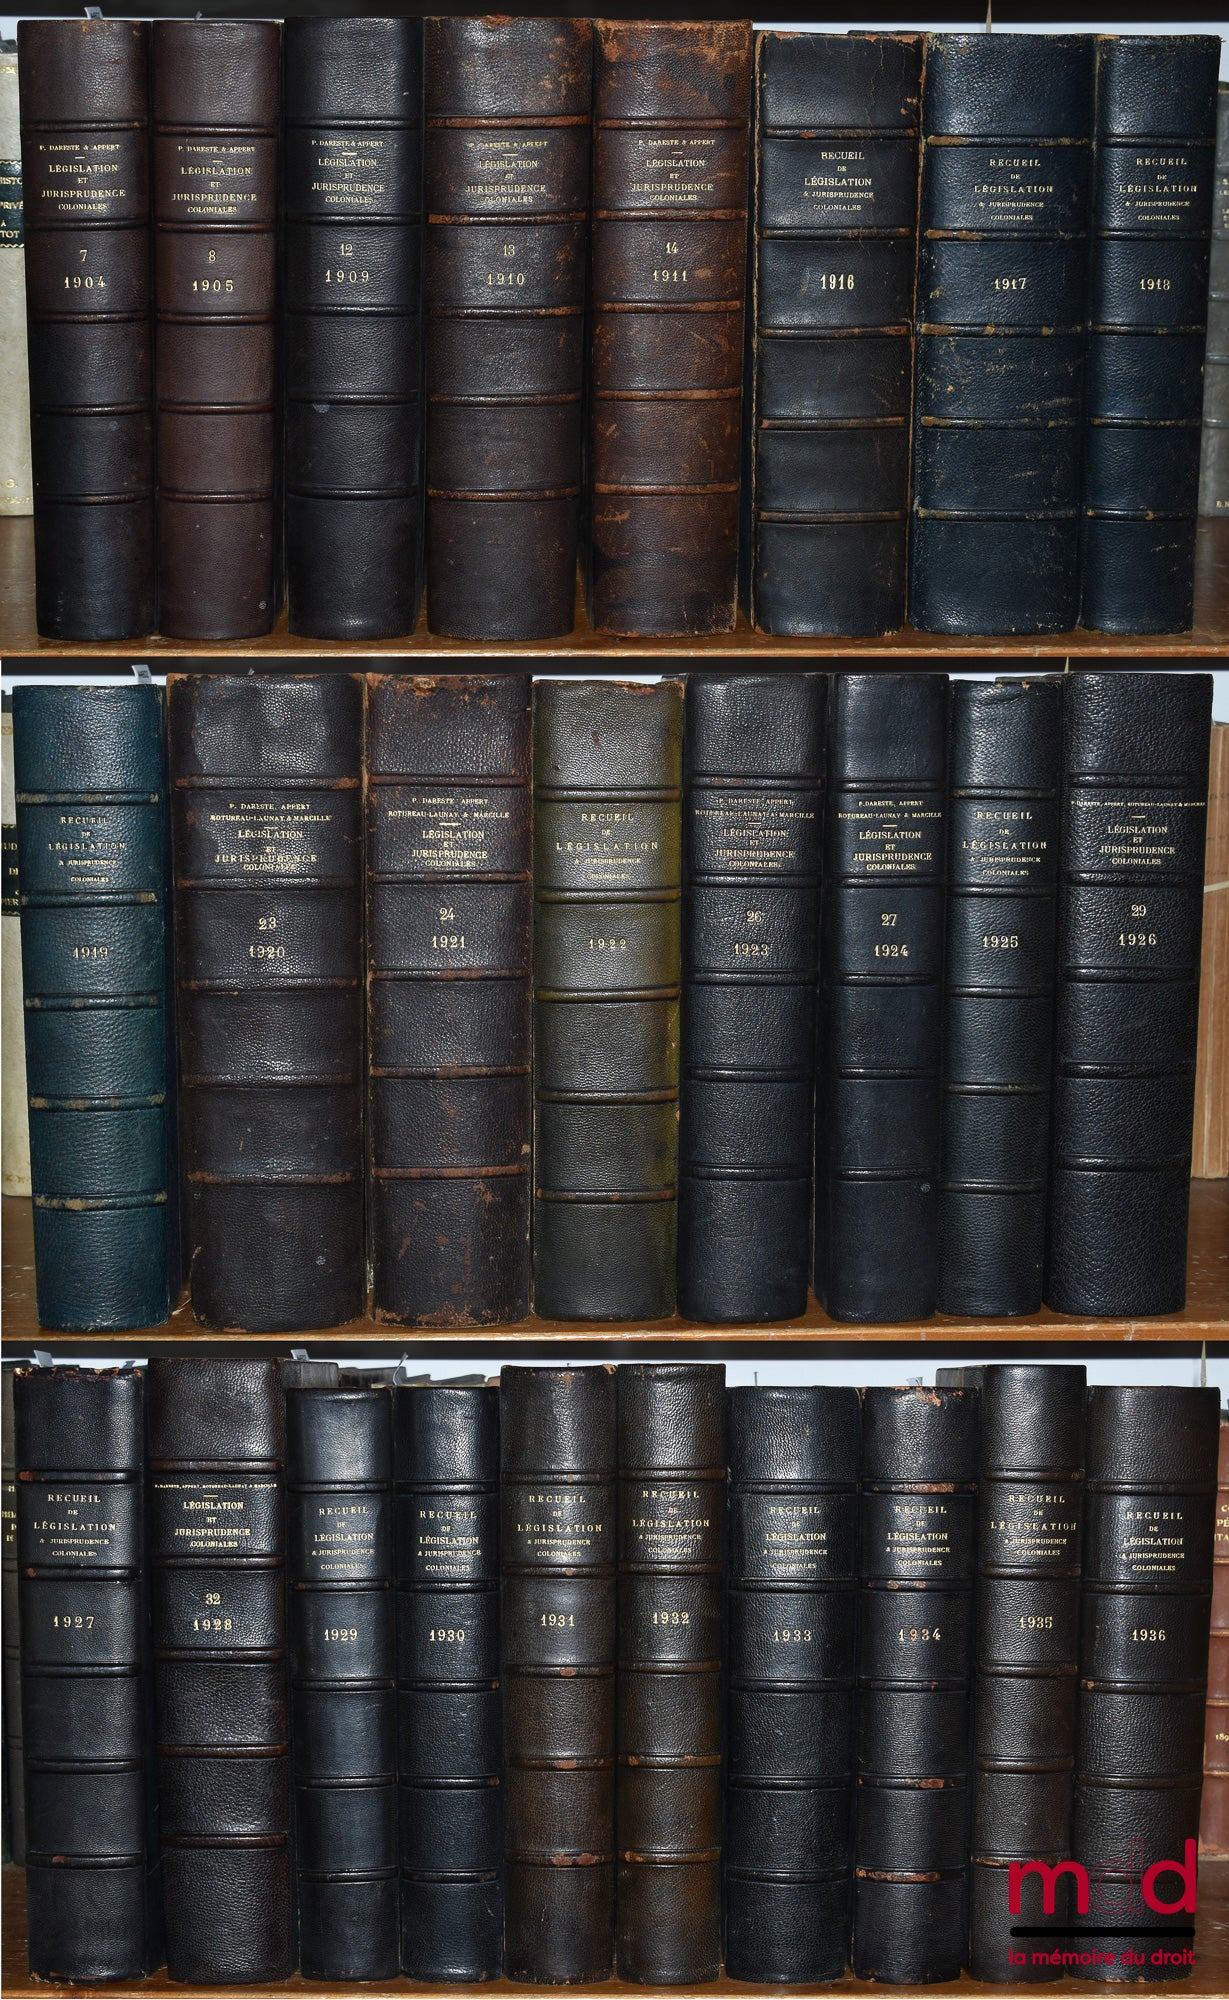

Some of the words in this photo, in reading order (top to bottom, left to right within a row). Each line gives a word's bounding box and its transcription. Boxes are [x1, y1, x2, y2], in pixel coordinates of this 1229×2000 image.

[647, 138, 678, 146] DARESTE
[318, 156, 377, 167] LÉGISLATION
[820, 152, 864, 160] RECUEIL
[49, 163, 119, 173] LÉGISLATION
[479, 158, 538, 168] LÉGISLATION
[646, 157, 705, 168] LÉGISLATION
[989, 159, 1040, 167] RECUEIL
[180, 166, 252, 175] LÉGISLATION
[210, 180, 220, 188] ET
[631, 182, 713, 192] JURISPRUDENCE
[804, 177, 872, 186] LÉGISLATION
[312, 183, 384, 192] JURISPRUDENCE
[466, 184, 546, 193] JURISPRUDENCE
[974, 183, 1053, 193] LÉGISLATION
[1119, 182, 1197, 193] LÉGISLATION
[42, 189, 125, 198] JURISPRUDENCE
[171, 193, 257, 202] JURISPRUDENCE
[650, 194, 697, 202] COLONIALES
[58, 203, 107, 211] COLONIALES
[340, 244, 353, 256] 12
[502, 244, 515, 256] 13
[665, 241, 678, 255] 14
[79, 249, 88, 262] 7
[208, 250, 216, 262] 8
[325, 270, 369, 283] 1909
[487, 273, 525, 285] 1910
[652, 269, 688, 283] 1911
[64, 277, 106, 289] 1904
[192, 279, 234, 292] 1905
[821, 275, 854, 290] 1916
[994, 278, 1026, 290] 1917
[1140, 278, 1170, 290] 1918
[581, 813, 635, 822] RECUEIL
[976, 811, 1032, 820] RECUEIL
[422, 829, 484, 840] LÉGISLATION
[723, 828, 787, 837] LÉGISLATION
[859, 829, 921, 840] LÉGISLATION
[1107, 824, 1168, 834] LÉGISLATION
[556, 840, 659, 851] LÉGISLATION
[962, 839, 1047, 849] LÉGISLATION
[411, 849, 488, 860] JURISPRUDENCE
[715, 849, 794, 858] JURISPRUDENCE
[1100, 846, 1175, 854] JURISPRUDENCE
[853, 852, 932, 861] JURISPRUDENCE
[439, 908, 455, 921] 24
[747, 910, 762, 923] 26
[1131, 905, 1146, 917] 29
[258, 917, 276, 930] 23
[881, 913, 897, 926] 27
[432, 935, 466, 949] 1921
[588, 938, 628, 949] 1922
[983, 936, 1018, 948] 1925
[1119, 933, 1156, 946] 1926
[73, 947, 108, 958] 1919
[248, 946, 284, 958] 1920
[734, 943, 768, 956] 1923
[874, 944, 908, 957] 1924
[48, 1494, 100, 1502] RECUEIL
[528, 1495, 585, 1503] RECUEIL
[642, 1490, 699, 1499] RECUEIL
[1008, 1495, 1065, 1503] RECUEIL
[183, 1501, 243, 1510] LÉGISLATION
[319, 1507, 369, 1515] RECUEIL
[770, 1506, 819, 1514] RECUEIL
[895, 1506, 946, 1514] RECUEIL
[420, 1511, 477, 1519] RECUEIL
[1127, 1511, 1182, 1520] RECUEIL
[34, 1520, 117, 1531] LÉGISLATION
[517, 1523, 602, 1533] LÉGISLATION
[632, 1518, 709, 1528] LÉGISLATION
[175, 1528, 251, 1537] JURISPRUDENCE
[314, 1531, 373, 1542] LÉGISLATION
[767, 1532, 826, 1541] LÉGISLATION
[888, 1531, 948, 1540] LÉGISLATION
[419, 1535, 479, 1545] LÉGISLATION
[206, 1593, 220, 1605] 32
[53, 1616, 94, 1628] 1927
[541, 1614, 574, 1627] 1931
[653, 1612, 689, 1624] 1932
[1019, 1616, 1052, 1629] 1935
[193, 1619, 232, 1631] 1928
[324, 1629, 357, 1641] 1929
[429, 1629, 465, 1642] 1930
[774, 1629, 811, 1641] 1933
[899, 1628, 940, 1641] 1934
[1132, 1629, 1166, 1641] 1936
